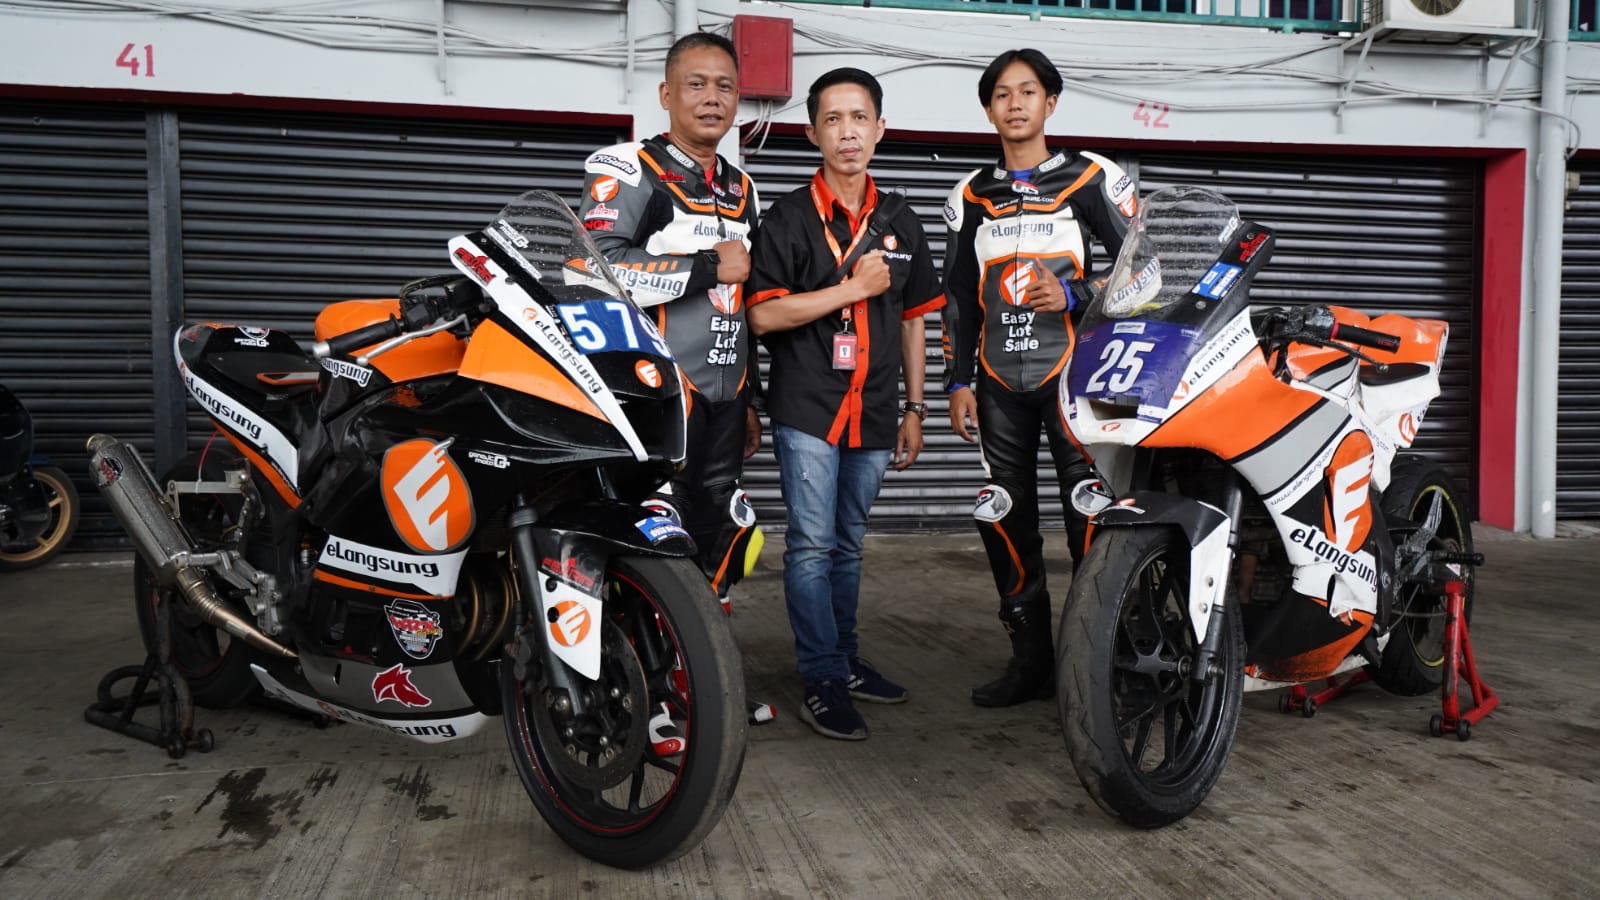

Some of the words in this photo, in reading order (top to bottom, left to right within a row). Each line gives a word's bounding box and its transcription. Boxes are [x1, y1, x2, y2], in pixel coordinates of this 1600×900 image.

[115, 43, 155, 77] 41
[1132, 100, 1169, 129] 42
[991, 222, 1054, 238] eLangsung
[559, 302, 673, 359] 579
[710, 317, 741, 334] Easy
[1001, 311, 1036, 325] Easy
[1008, 324, 1033, 338] Lot
[534, 319, 604, 395] eLangsung
[707, 349, 738, 365] Sale
[715, 334, 737, 349] Lot
[1004, 338, 1040, 352] Sale
[1189, 327, 1251, 385] eLangsung
[1085, 339, 1155, 394] 25
[185, 376, 262, 440] eLangsung
[326, 541, 440, 577] eLangsung
[1289, 528, 1378, 593] eLangsung
